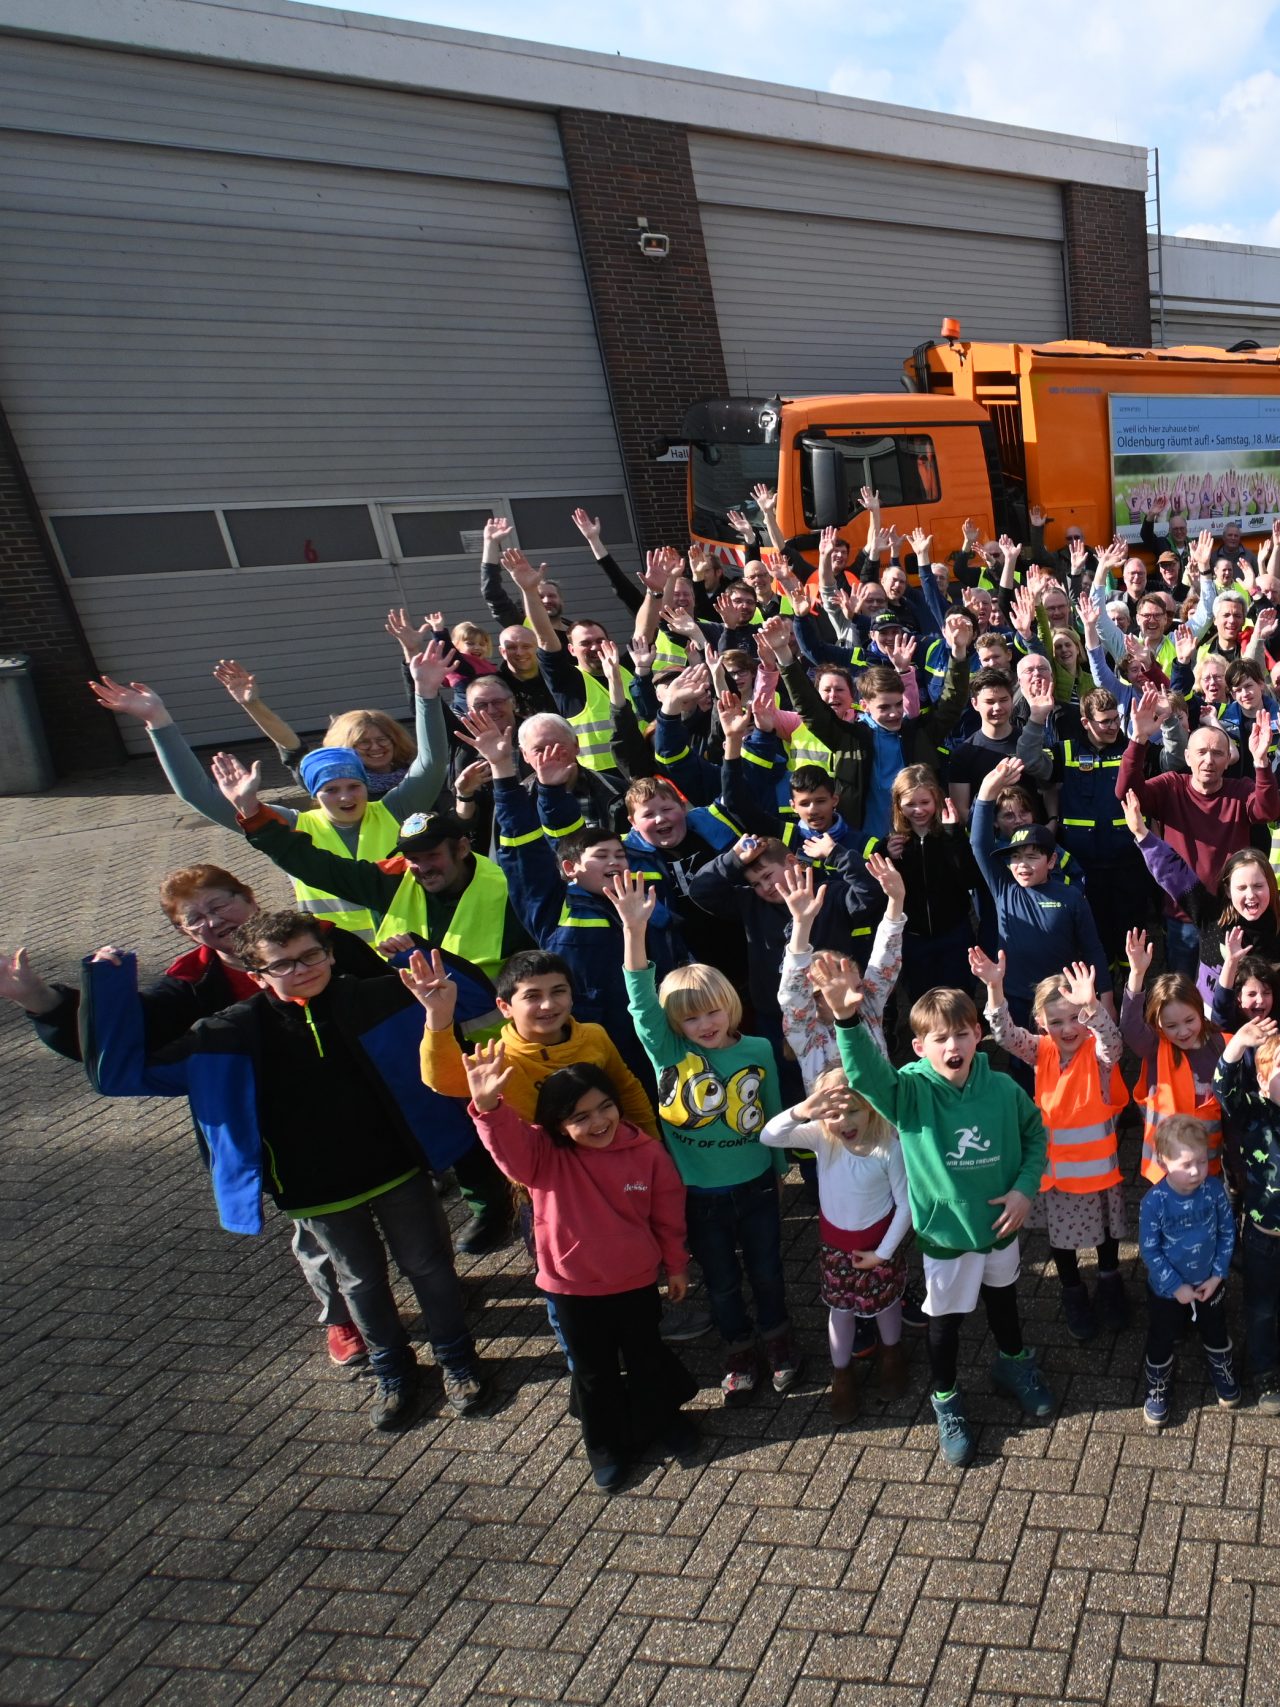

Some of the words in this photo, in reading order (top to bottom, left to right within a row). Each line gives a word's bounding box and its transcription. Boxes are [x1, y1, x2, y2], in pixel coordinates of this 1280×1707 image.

[1123, 424, 1137, 433] weil
[1137, 424, 1147, 433] ich
[1149, 424, 1161, 433] hier
[1161, 424, 1188, 433] zuhause
[1188, 424, 1200, 432] bin!
[1117, 436, 1165, 449] Oldenburg
[1167, 435, 1192, 446] räumt
[1194, 434, 1210, 446] auf!
[1216, 434, 1250, 447] Samstag,
[1252, 434, 1264, 445] 18.
[304, 540, 318, 563] 6
[671, 1131, 696, 1146] OUT
[698, 1140, 716, 1148] OF
